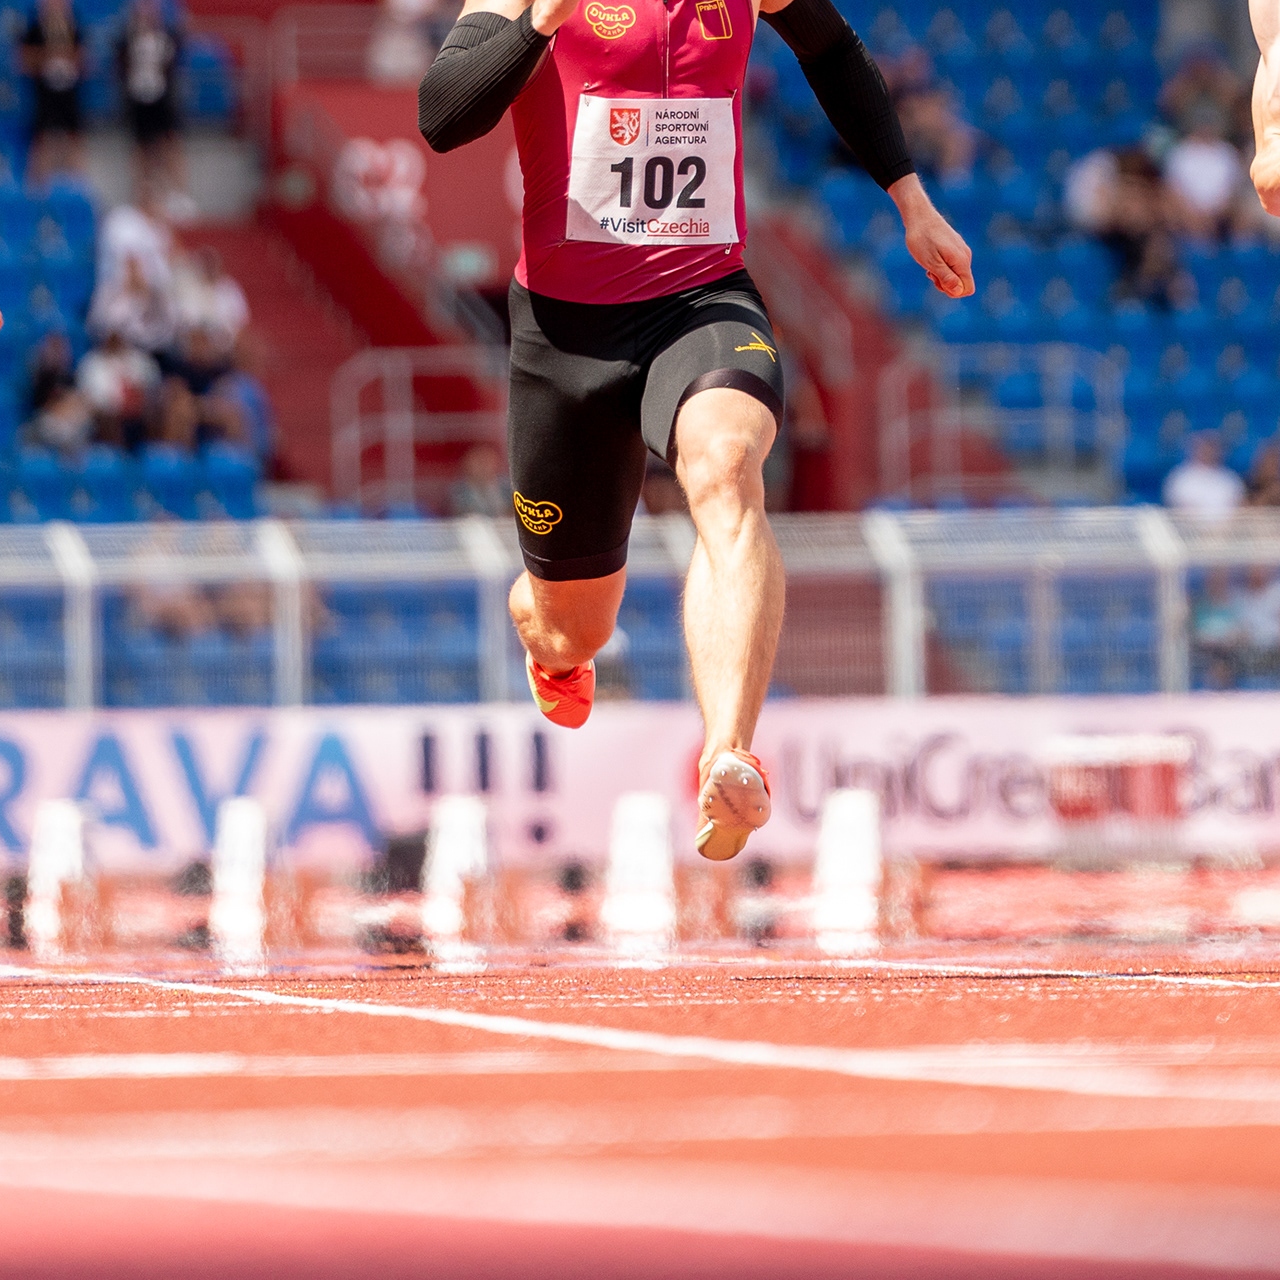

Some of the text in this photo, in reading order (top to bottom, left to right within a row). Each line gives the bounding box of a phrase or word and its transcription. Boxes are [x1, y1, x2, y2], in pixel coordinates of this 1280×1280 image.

[589, 6, 631, 22] DUKLA
[597, 25, 622, 36] PRAHA
[655, 108, 700, 120] NÁRODNÍ
[654, 121, 709, 132] SPORTOVNÍ
[654, 135, 707, 145] AGENTURA
[610, 155, 707, 210] 102
[599, 217, 711, 238] #VisitCzechia
[516, 496, 554, 518] DUKLA
